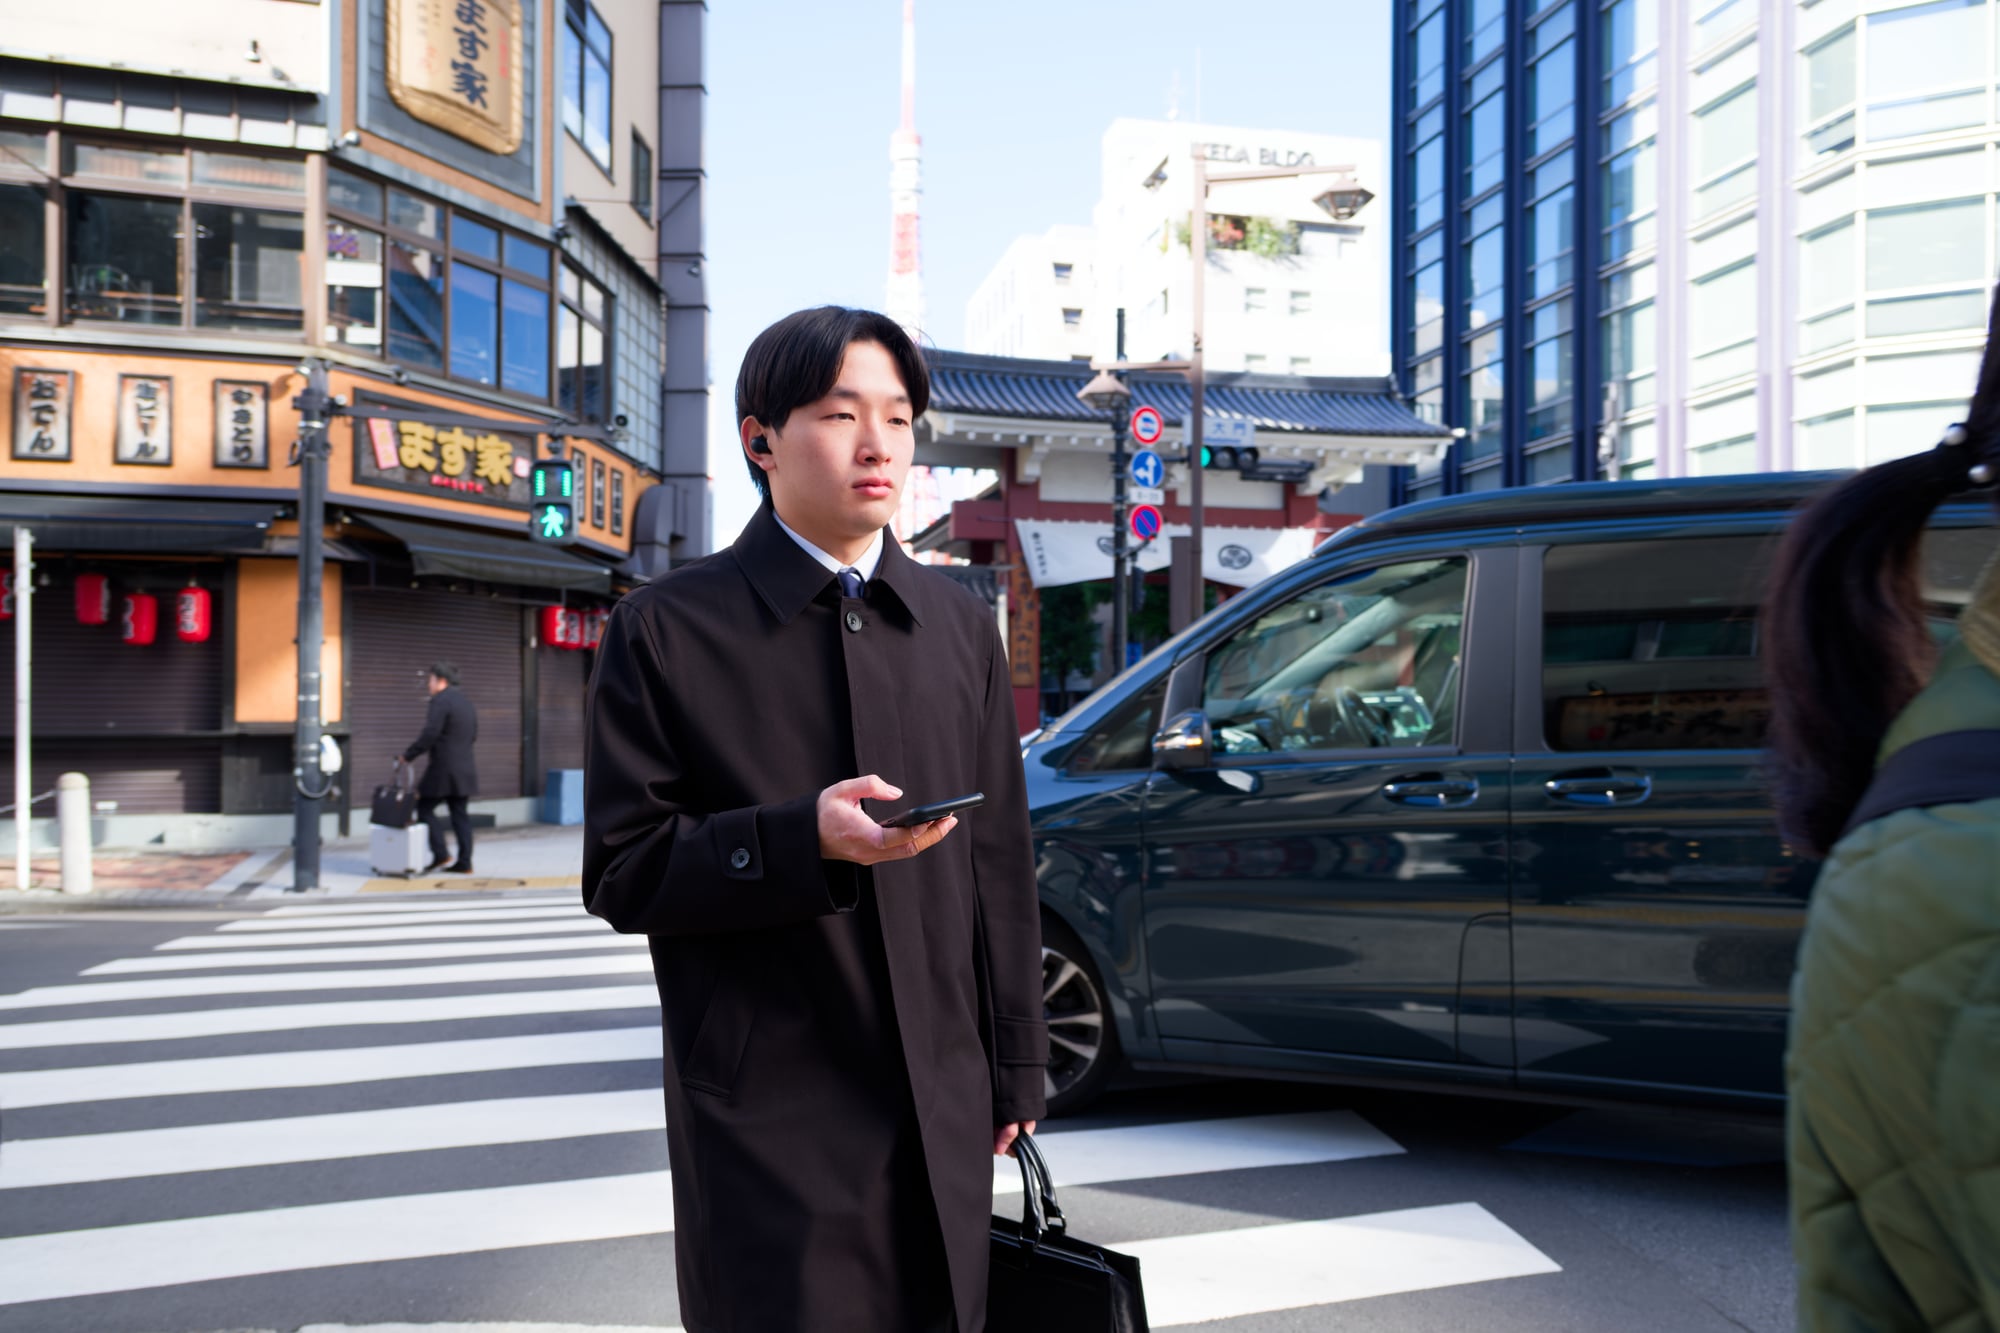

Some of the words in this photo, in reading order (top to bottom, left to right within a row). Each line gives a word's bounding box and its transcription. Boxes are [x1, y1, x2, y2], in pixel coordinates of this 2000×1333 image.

[449, 0, 490, 109] ます家
[30, 378, 58, 453] おでん
[134, 382, 159, 459] 生ビール
[231, 388, 254, 463] やきとり
[397, 419, 514, 486] ます家
